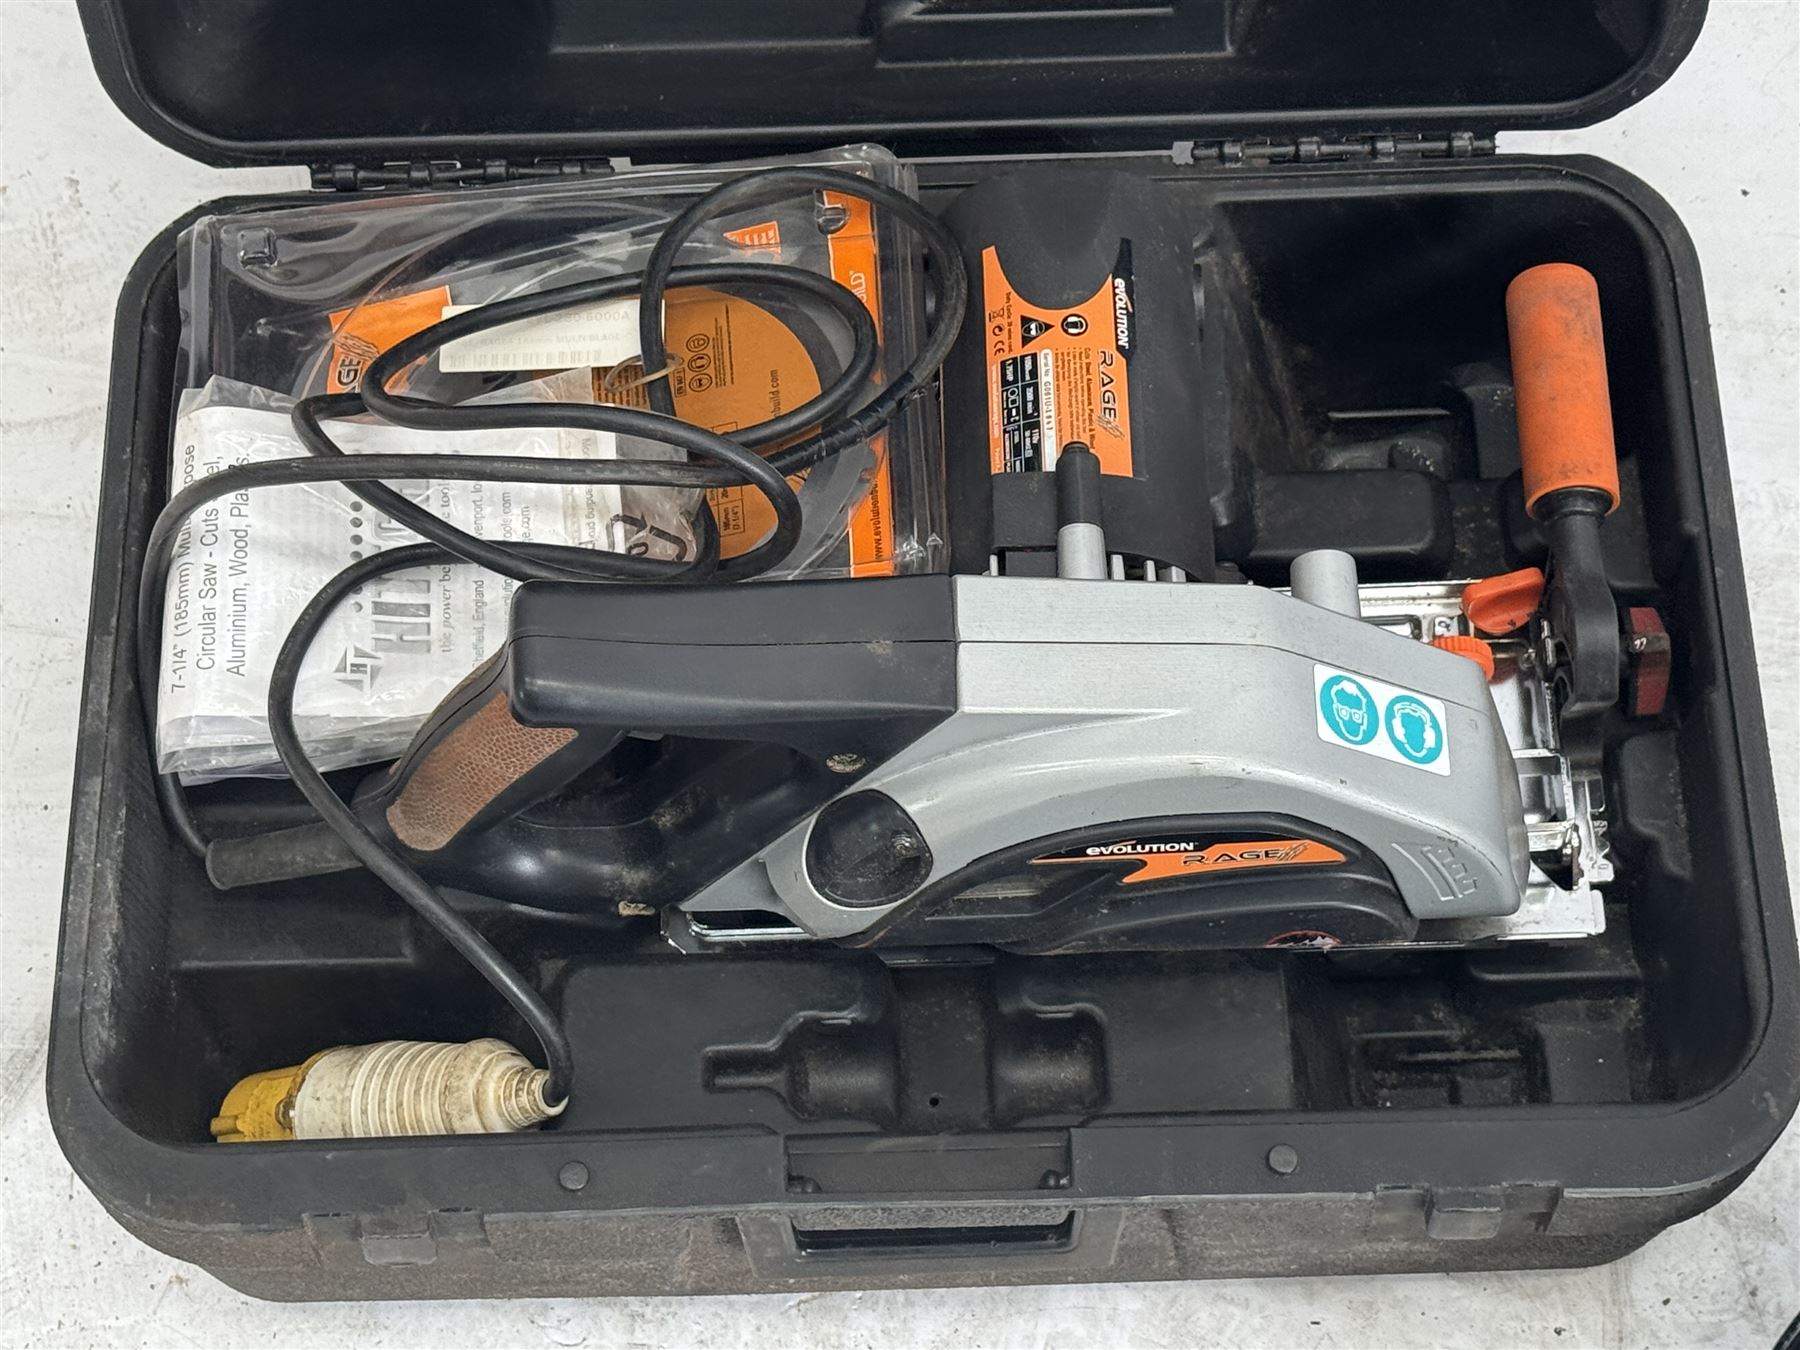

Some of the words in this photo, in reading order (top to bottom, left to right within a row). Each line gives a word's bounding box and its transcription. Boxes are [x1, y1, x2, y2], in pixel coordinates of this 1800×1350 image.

[1100, 350, 1117, 419] RAGE
[200, 508, 219, 546] Cuts
[228, 525, 251, 577] Wood,
[173, 562, 194, 637] (185mm)
[198, 563, 217, 599] Saw
[472, 580, 487, 621] England
[225, 583, 250, 677] Aluminium,
[441, 585, 454, 630] power
[196, 604, 216, 670] Circular
[1183, 849, 1280, 866] RAGE
